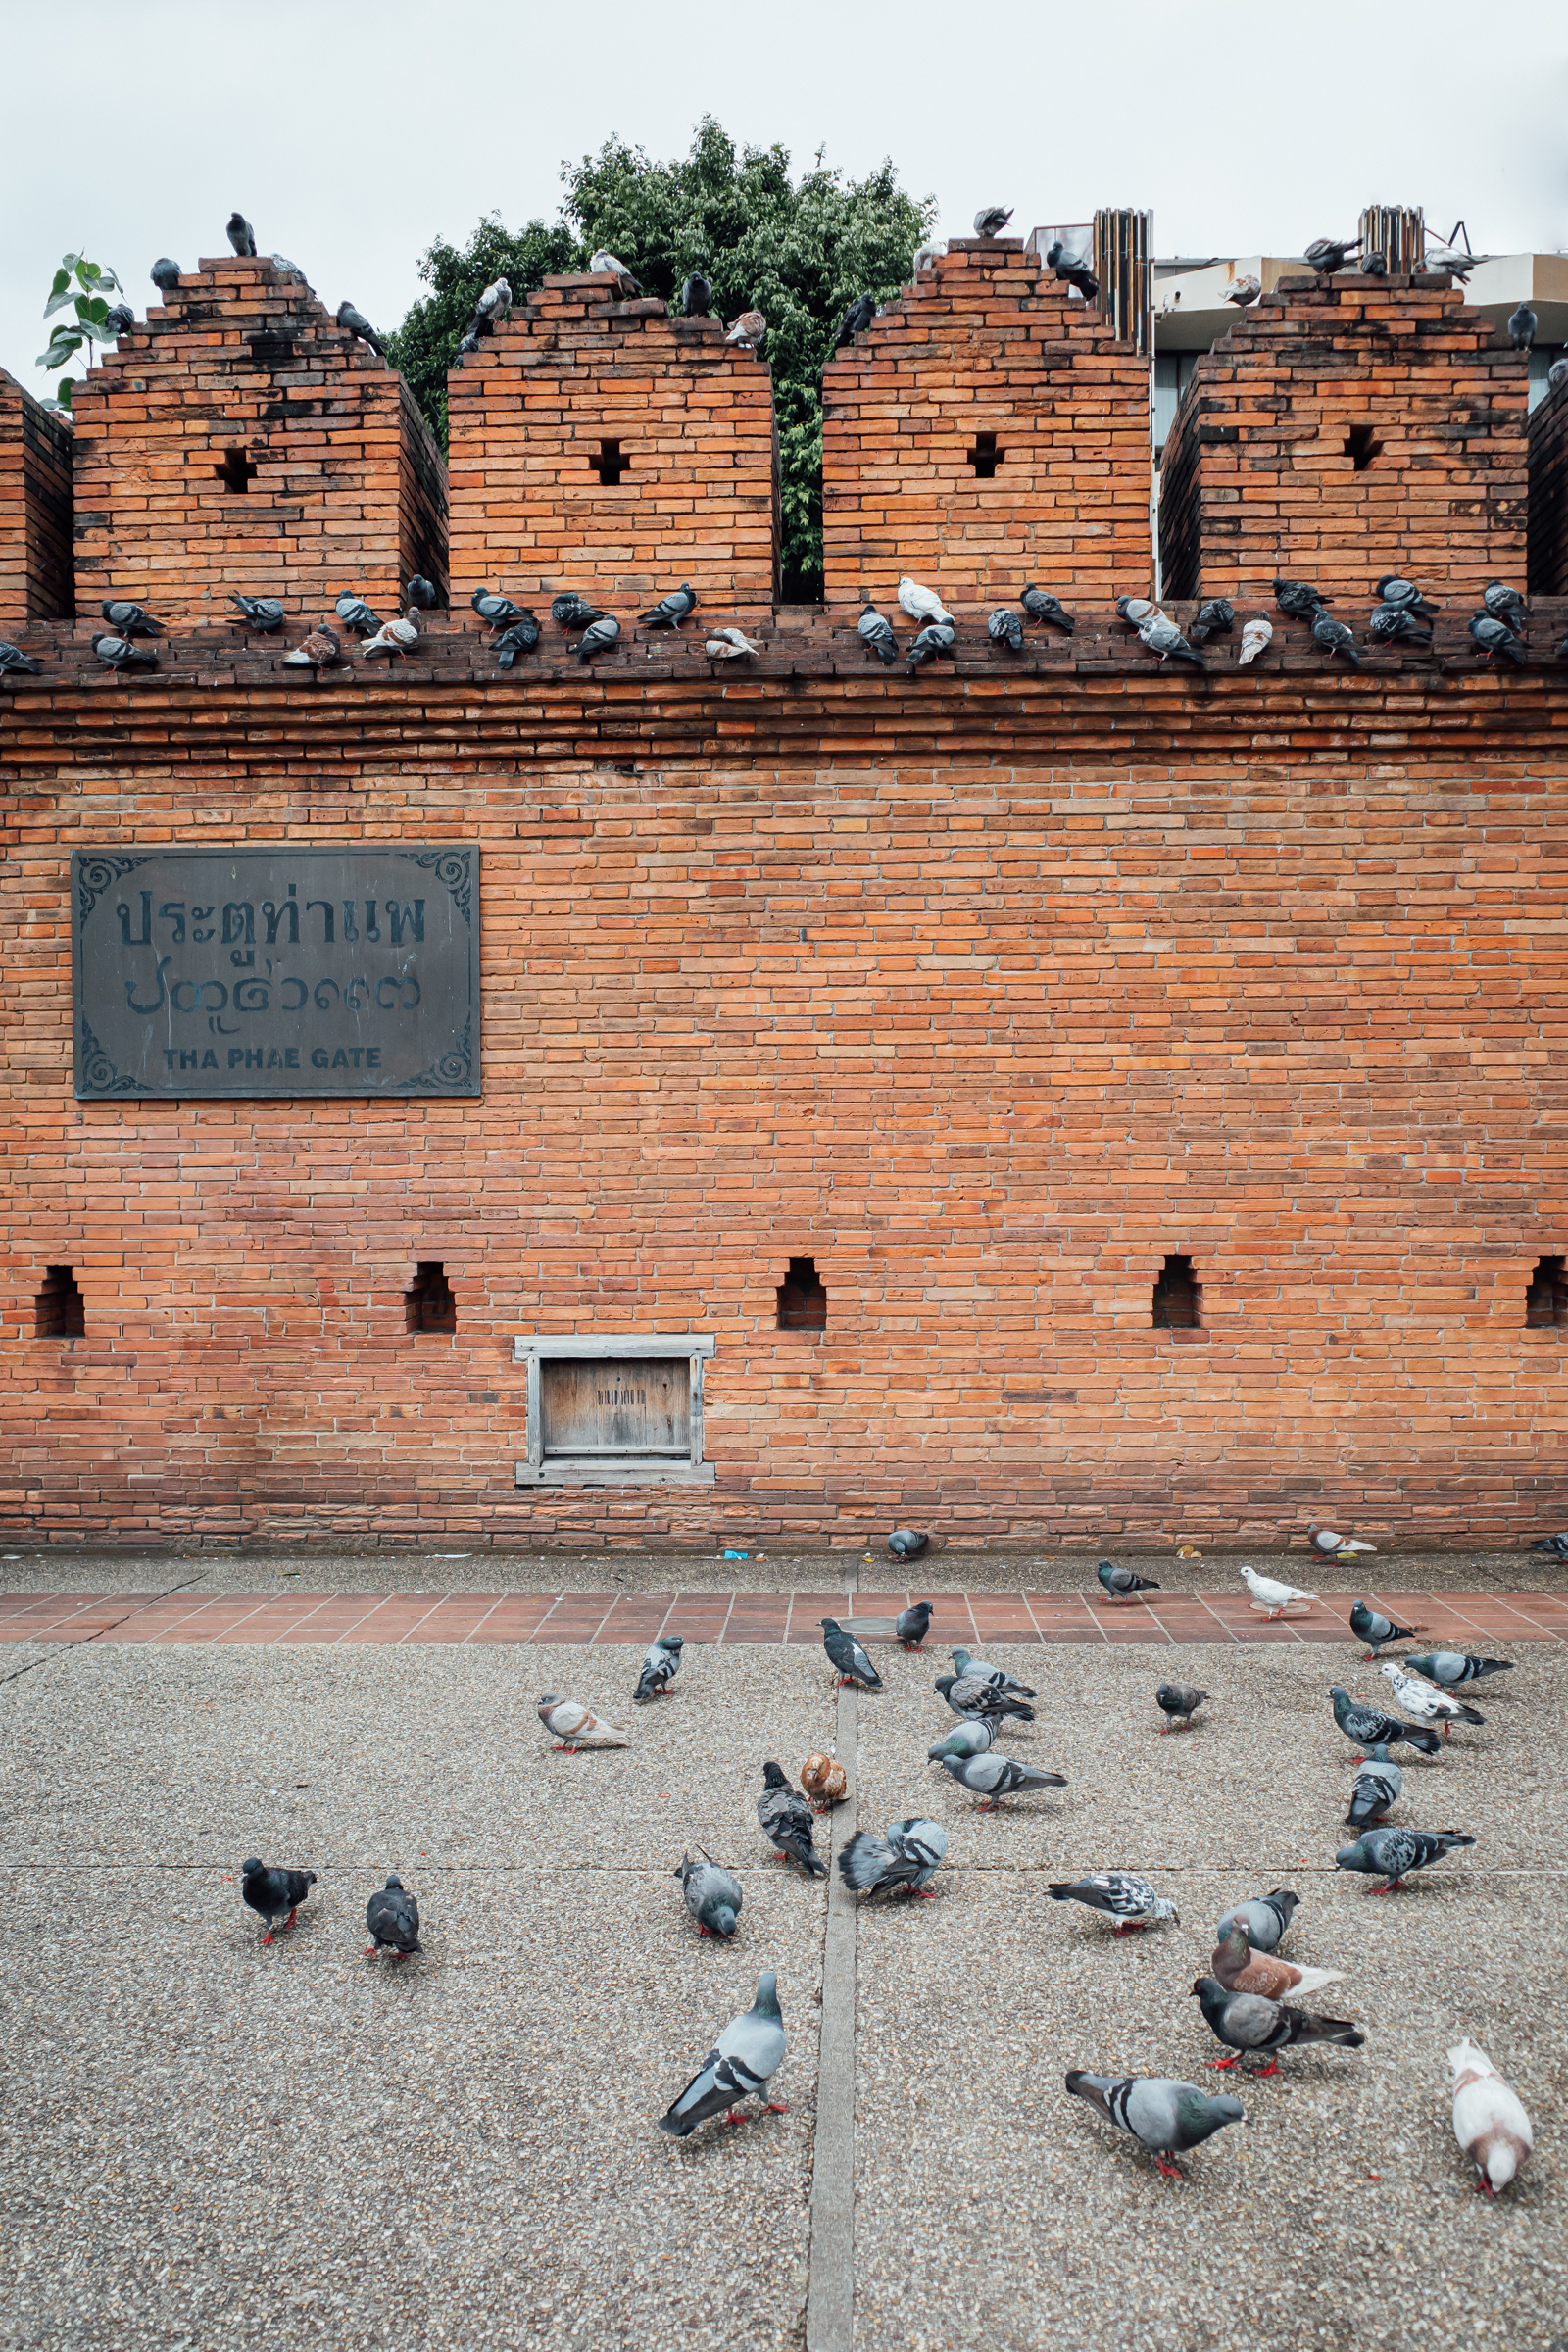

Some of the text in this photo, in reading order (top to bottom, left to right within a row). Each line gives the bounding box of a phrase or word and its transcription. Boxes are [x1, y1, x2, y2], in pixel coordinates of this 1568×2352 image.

[116, 884, 426, 968] ประตูท่าแพ
[163, 1047, 382, 1070] THA PHAE GATE
